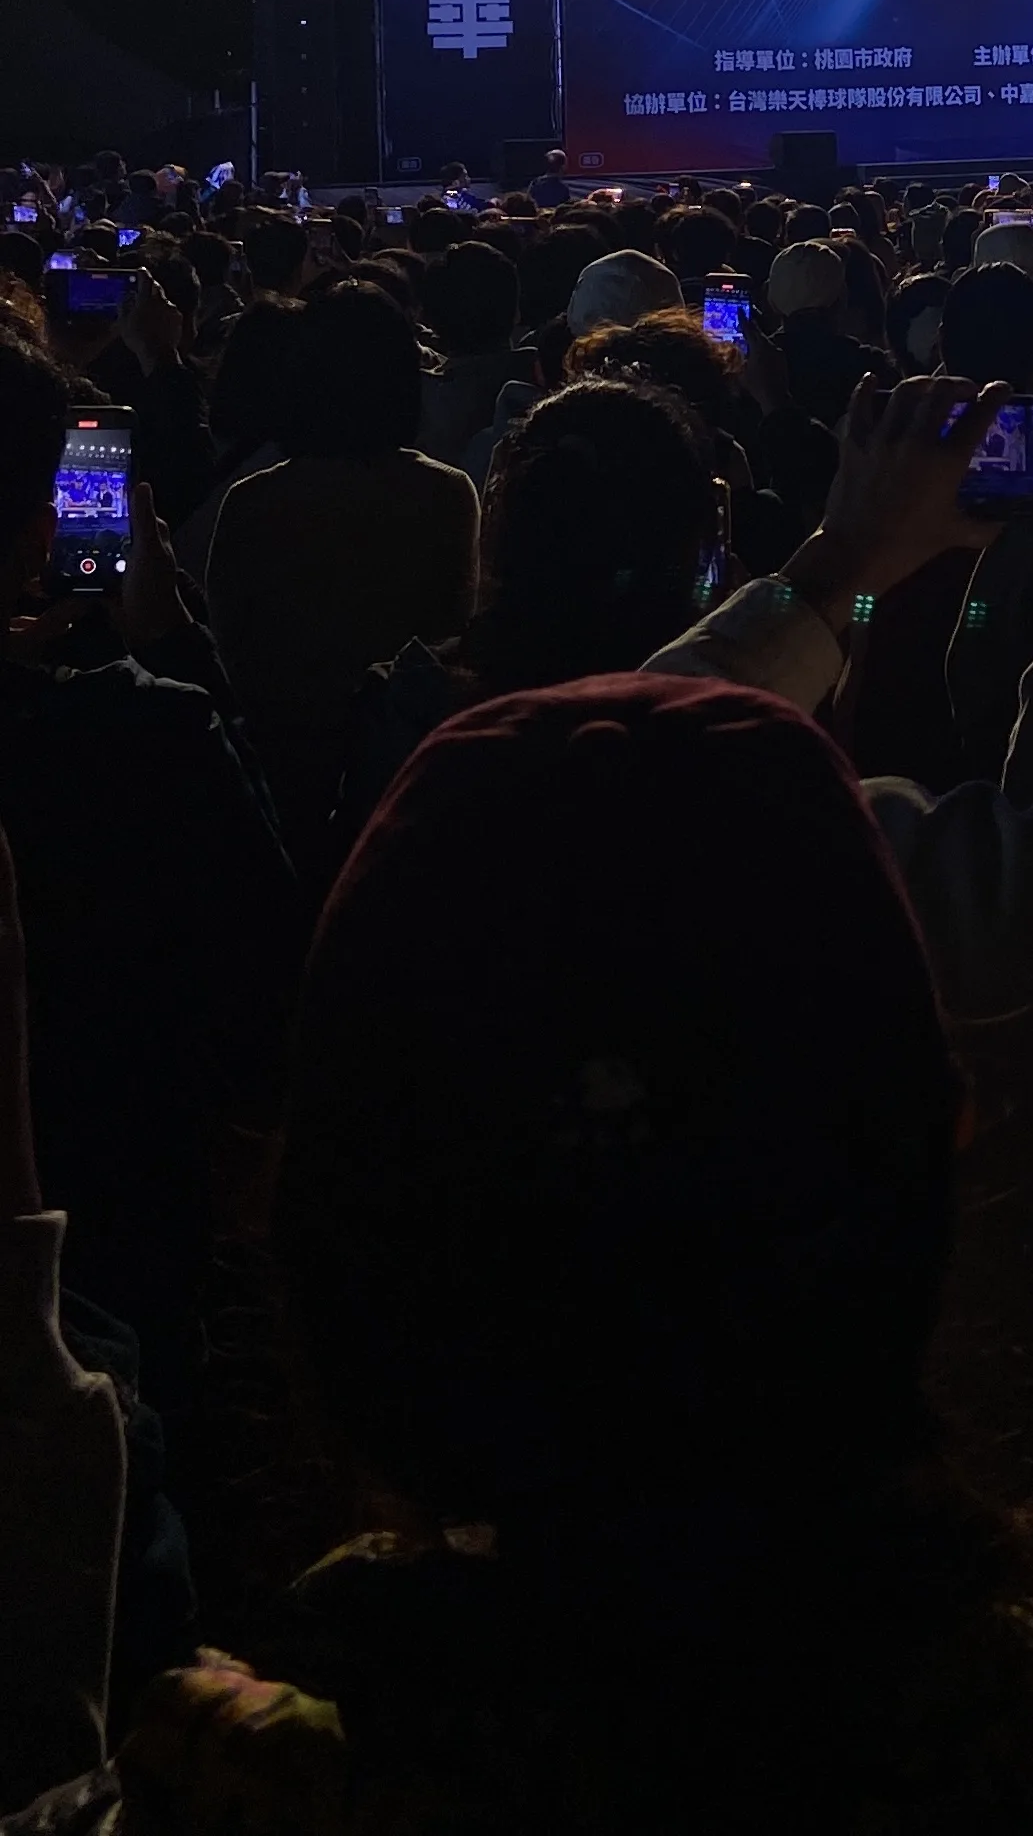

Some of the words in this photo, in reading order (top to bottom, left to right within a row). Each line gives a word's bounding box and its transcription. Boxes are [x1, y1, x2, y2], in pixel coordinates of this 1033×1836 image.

[714, 47, 913, 72] 指導單位：桃園市政府
